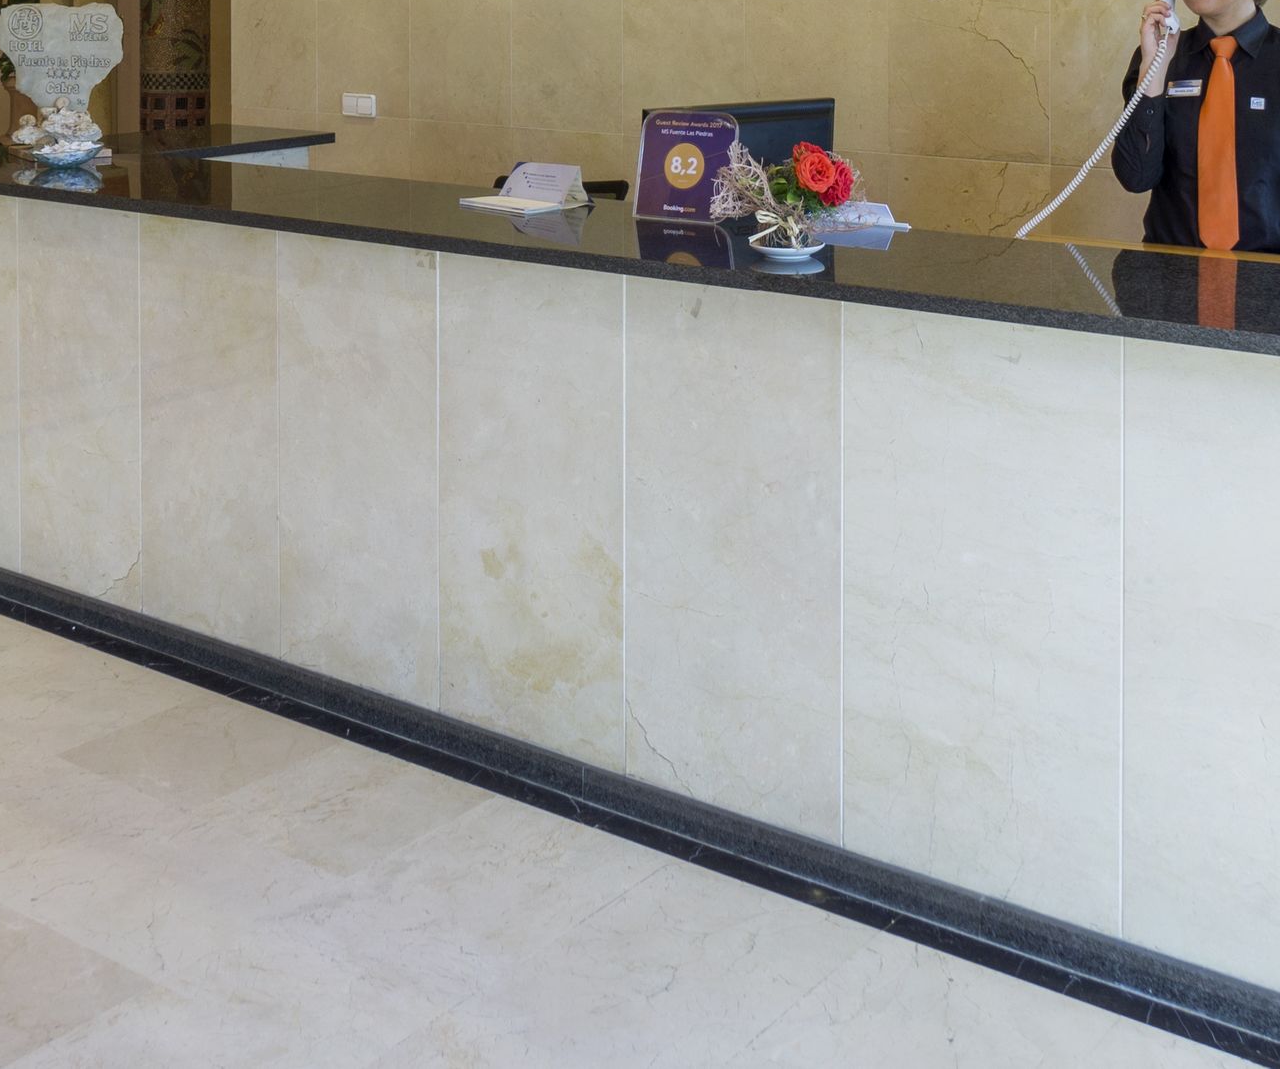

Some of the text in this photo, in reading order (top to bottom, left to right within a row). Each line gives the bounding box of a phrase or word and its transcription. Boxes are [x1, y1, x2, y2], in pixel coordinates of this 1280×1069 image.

[69, 13, 109, 34] MS
[8, 41, 45, 53] HOTEL
[17, 54, 56, 68] Fuente
[70, 54, 112, 70] Piedras
[45, 82, 80, 95] Cabra
[655, 118, 671, 126] Guest
[671, 119, 690, 127] Review
[670, 156, 698, 176] 8,2
[663, 203, 696, 213] Booking.com
